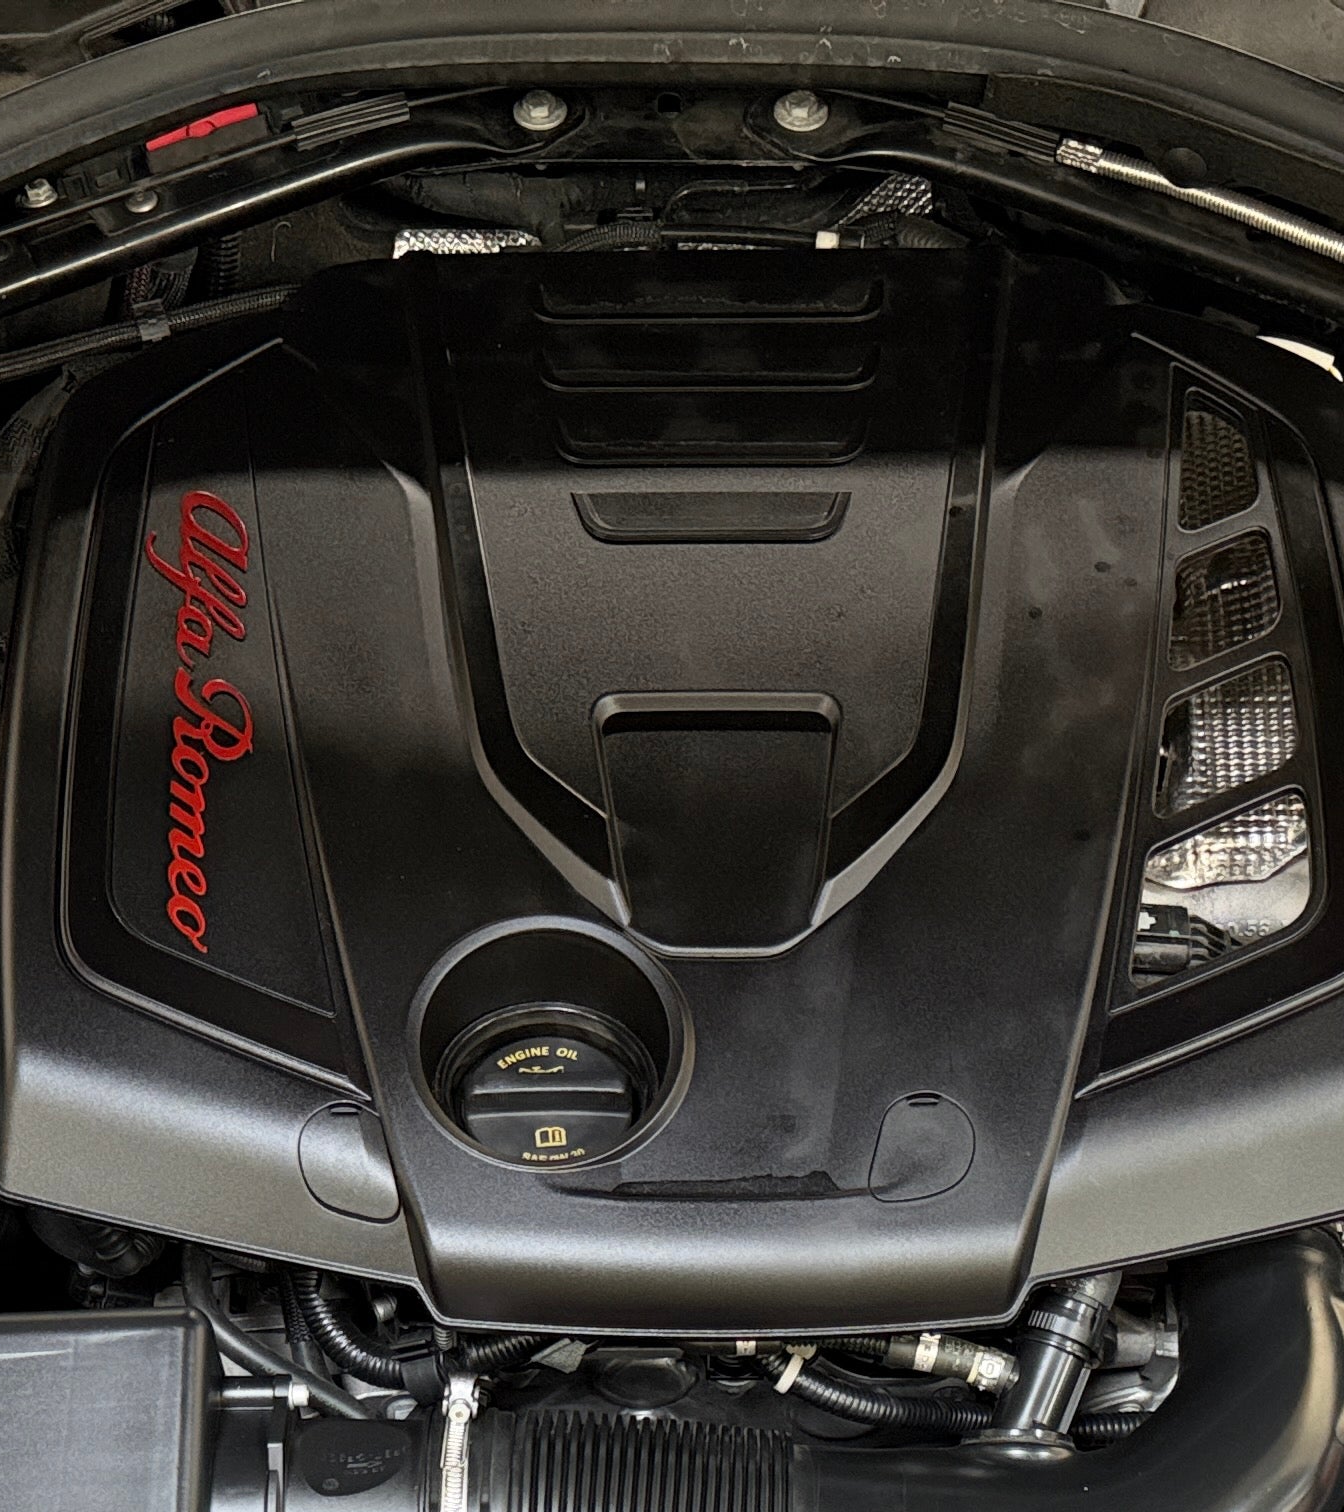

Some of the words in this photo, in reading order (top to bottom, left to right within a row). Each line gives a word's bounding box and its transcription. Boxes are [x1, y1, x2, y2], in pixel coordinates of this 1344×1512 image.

[146, 490, 248, 669] Alfa
[167, 667, 253, 953] Romeo
[496, 1046, 550, 1070] ENGINE
[555, 1047, 578, 1061] OIL
